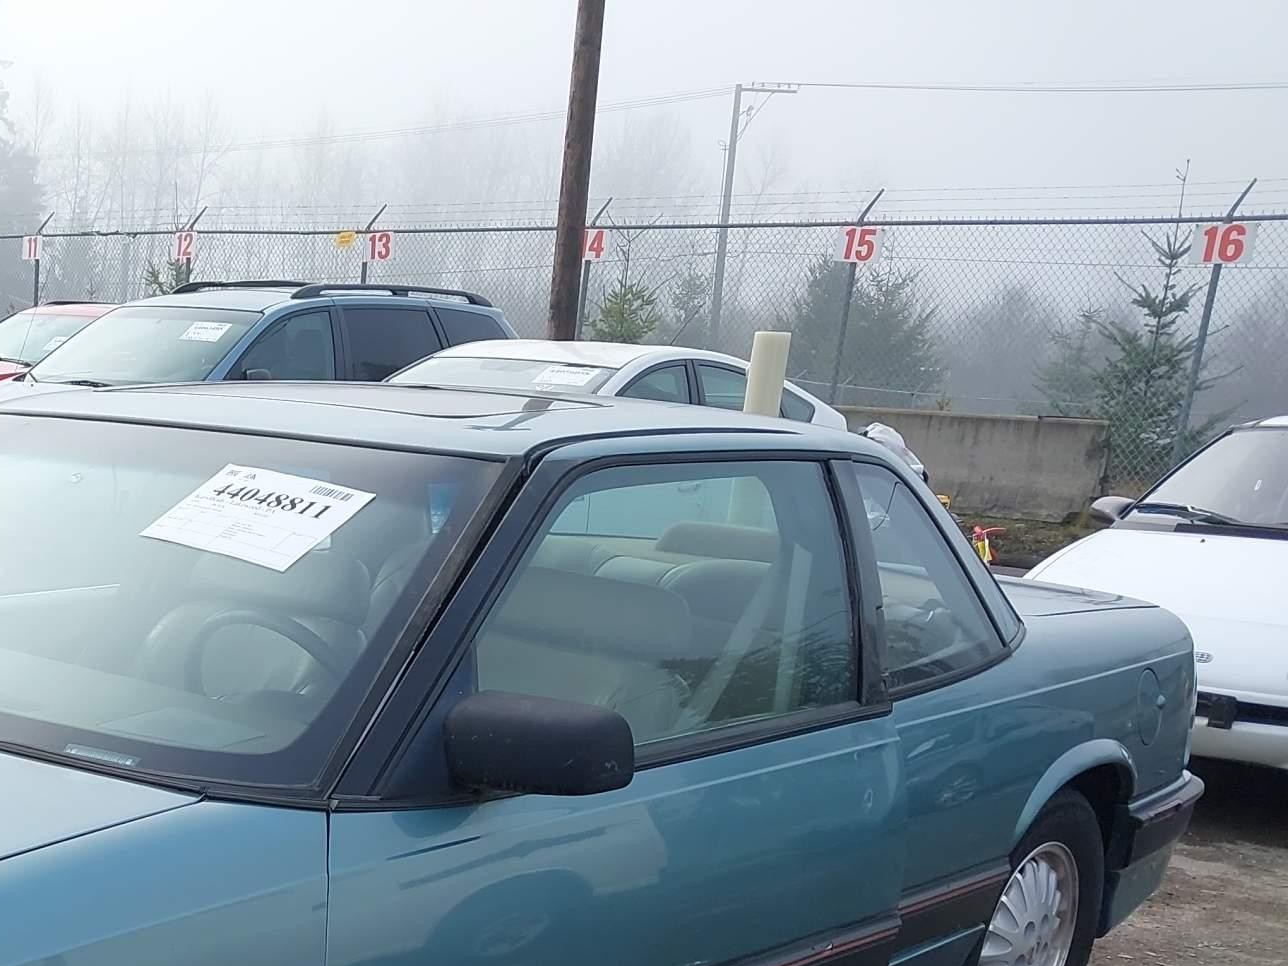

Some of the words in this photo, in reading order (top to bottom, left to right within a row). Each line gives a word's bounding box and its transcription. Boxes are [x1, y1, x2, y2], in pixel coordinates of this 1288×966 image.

[27, 237, 38, 258] 11
[177, 233, 194, 257] 12
[369, 232, 391, 260] 13
[843, 228, 877, 261] 15
[1202, 224, 1246, 262] 16
[213, 483, 332, 519] 44048811
